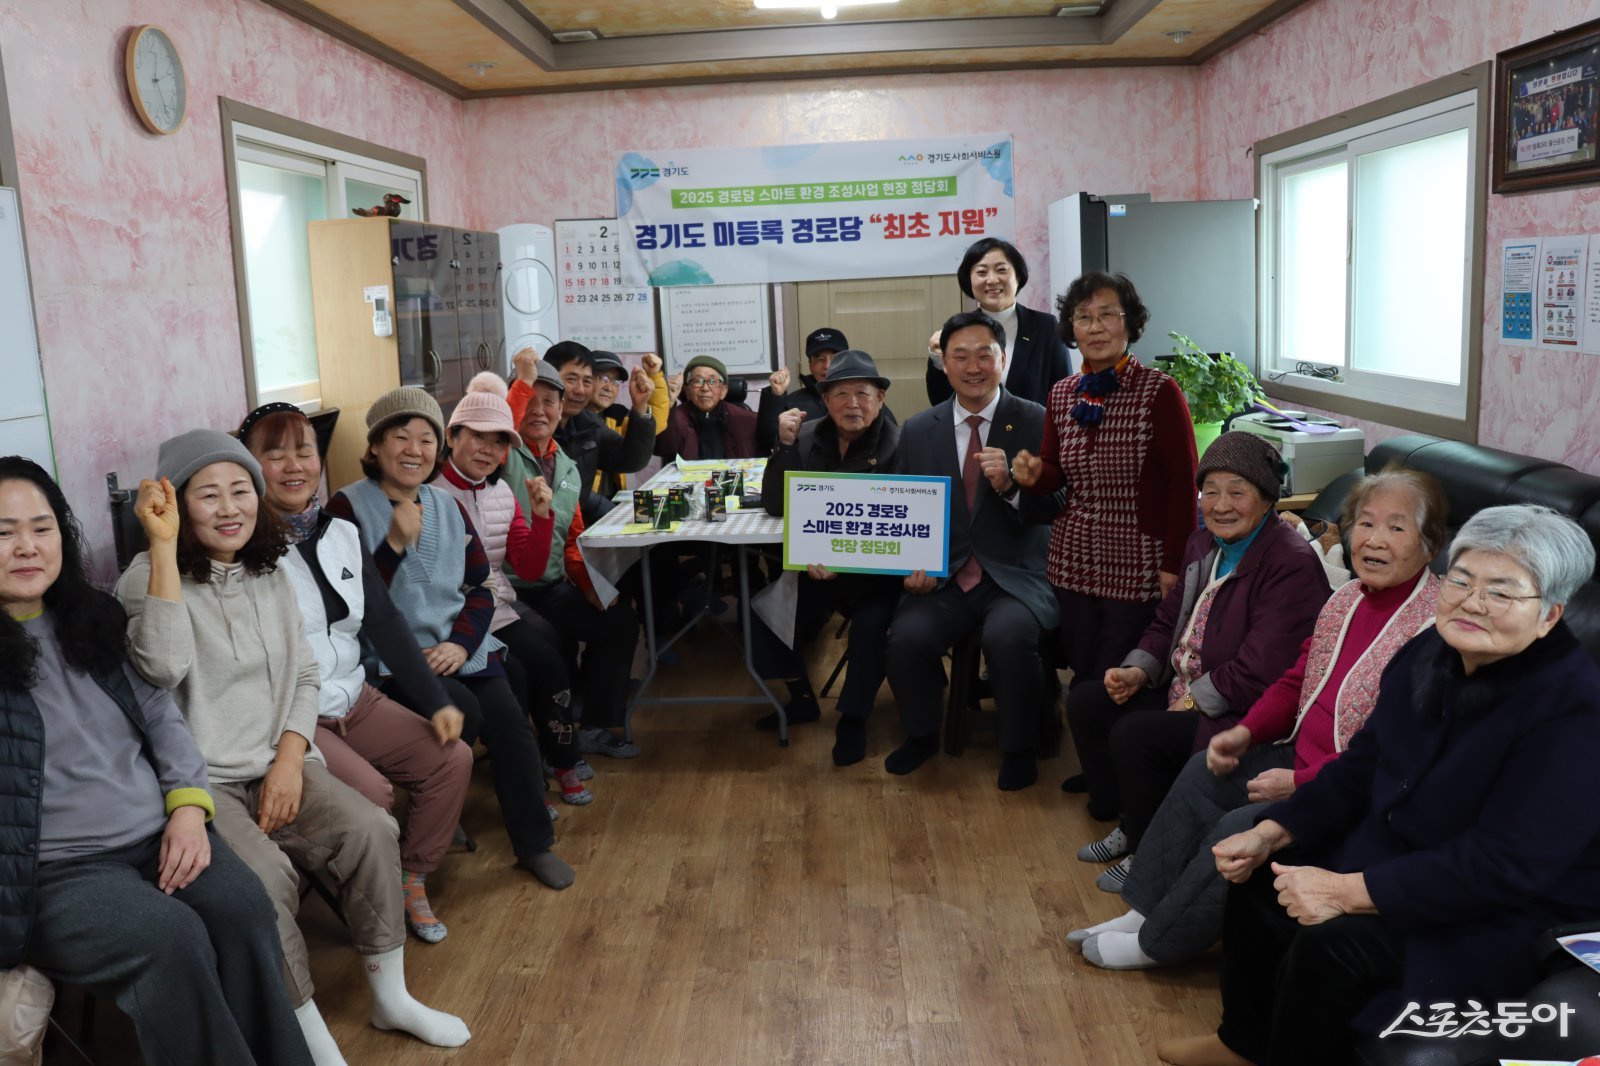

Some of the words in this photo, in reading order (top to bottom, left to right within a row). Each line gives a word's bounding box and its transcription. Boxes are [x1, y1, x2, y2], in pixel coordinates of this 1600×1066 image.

[927, 149, 1001, 163] 경기도사회서비스원
[662, 166, 689, 177] 경기도
[680, 192, 714, 204] 2025
[718, 189, 755, 203] 경로당
[759, 187, 796, 201] 스마트
[800, 185, 824, 200] 환경
[828, 183, 879, 198] 조성사업
[882, 182, 908, 195] 현장
[911, 179, 948, 195] 정담회
[600, 226, 608, 238] 2
[635, 222, 706, 250] 경기도
[713, 219, 784, 247] 미등록
[791, 215, 863, 244] 경로당
[577, 245, 583, 254] 2
[590, 245, 595, 254] 3
[602, 245, 607, 253] 4
[614, 244, 619, 253] 5
[578, 262, 583, 271] 9
[588, 262, 597, 270] 10
[601, 262, 608, 270] 11
[613, 261, 621, 270] 12
[565, 279, 573, 287] 15
[577, 278, 585, 287] 16
[590, 278, 597, 286] 17
[602, 278, 609, 286] 18
[613, 278, 621, 286] 19
[565, 295, 574, 304] 22
[577, 294, 586, 303] 23
[589, 294, 598, 302] 24
[601, 293, 611, 302] 25
[613, 293, 623, 302] 26
[626, 293, 635, 301] 27
[638, 293, 647, 301] 28
[818, 484, 835, 492] 경기도
[889, 487, 938, 495] 경기도사회서비스원
[825, 502, 864, 517] 2025
[867, 503, 909, 519] 경로당
[802, 519, 843, 535] 스마트
[845, 520, 873, 536] 환경
[875, 522, 930, 539] 조성사업
[830, 538, 857, 553] 현장
[860, 540, 901, 555] 정담회
